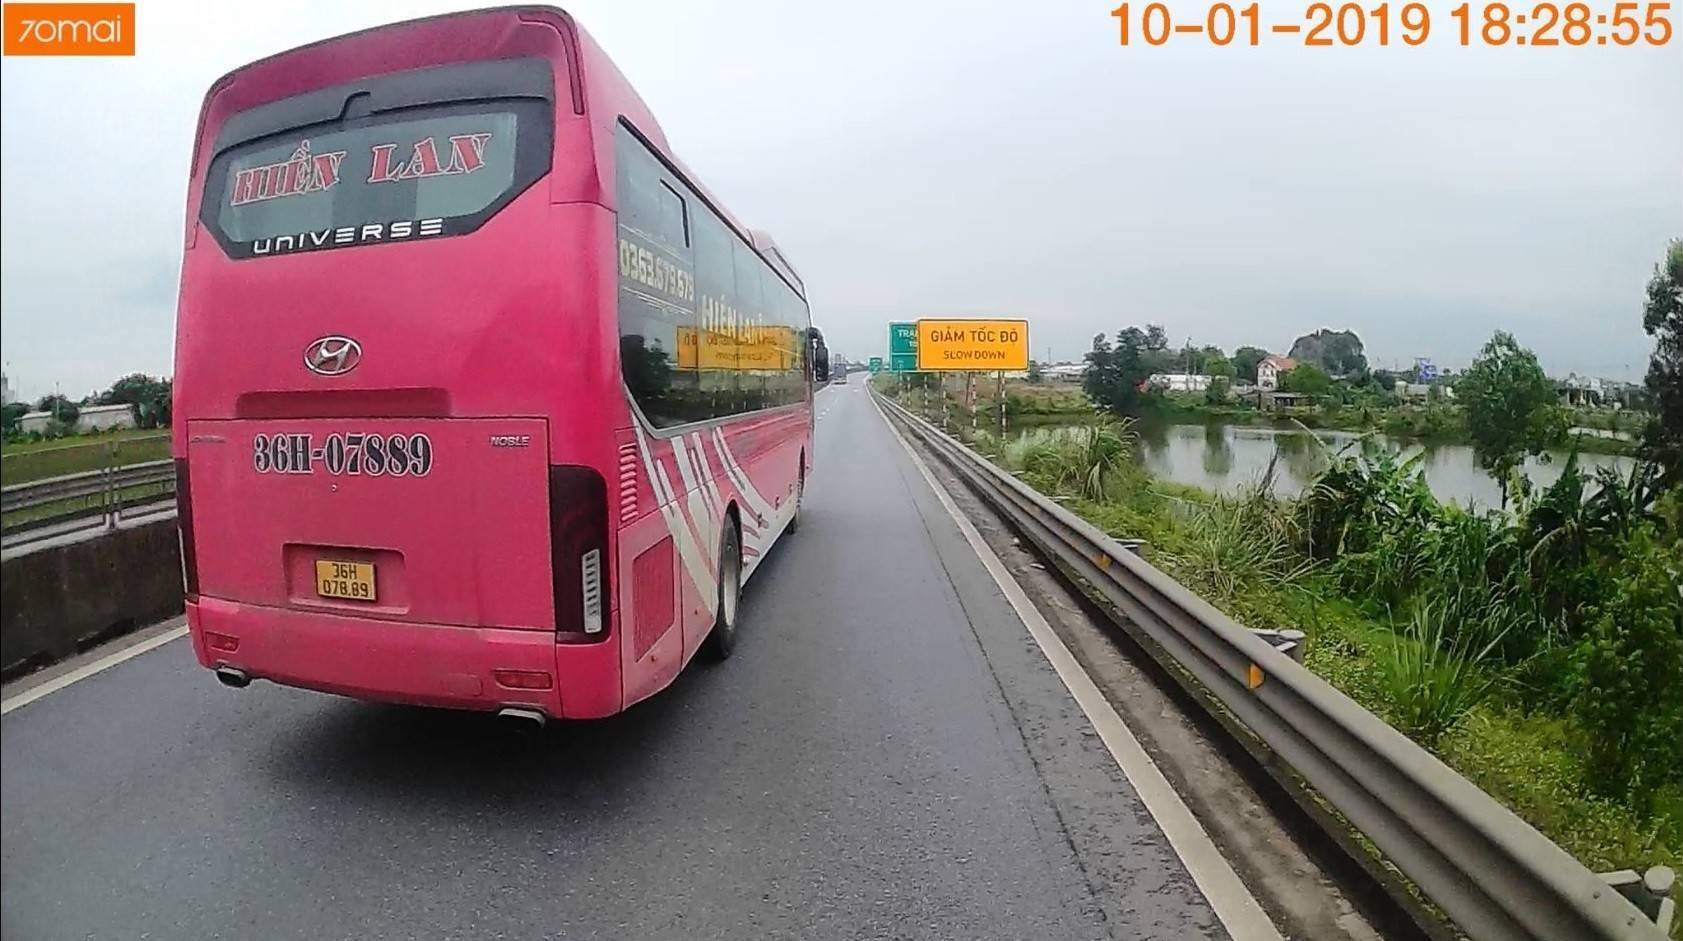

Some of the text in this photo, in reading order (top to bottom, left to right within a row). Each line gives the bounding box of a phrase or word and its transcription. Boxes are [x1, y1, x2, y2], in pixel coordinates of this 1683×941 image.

[366, 133, 492, 183] LAN
[253, 218, 443, 254] UNIVERSE
[930, 325, 1018, 345] GIẢM TỐC ĐỘ
[943, 350, 1006, 360] SLOW DOWN
[490, 435, 530, 447] NOBLE
[254, 433, 433, 476] 36H-07889
[331, 562, 358, 580] 36H
[322, 579, 369, 598] 078.89
